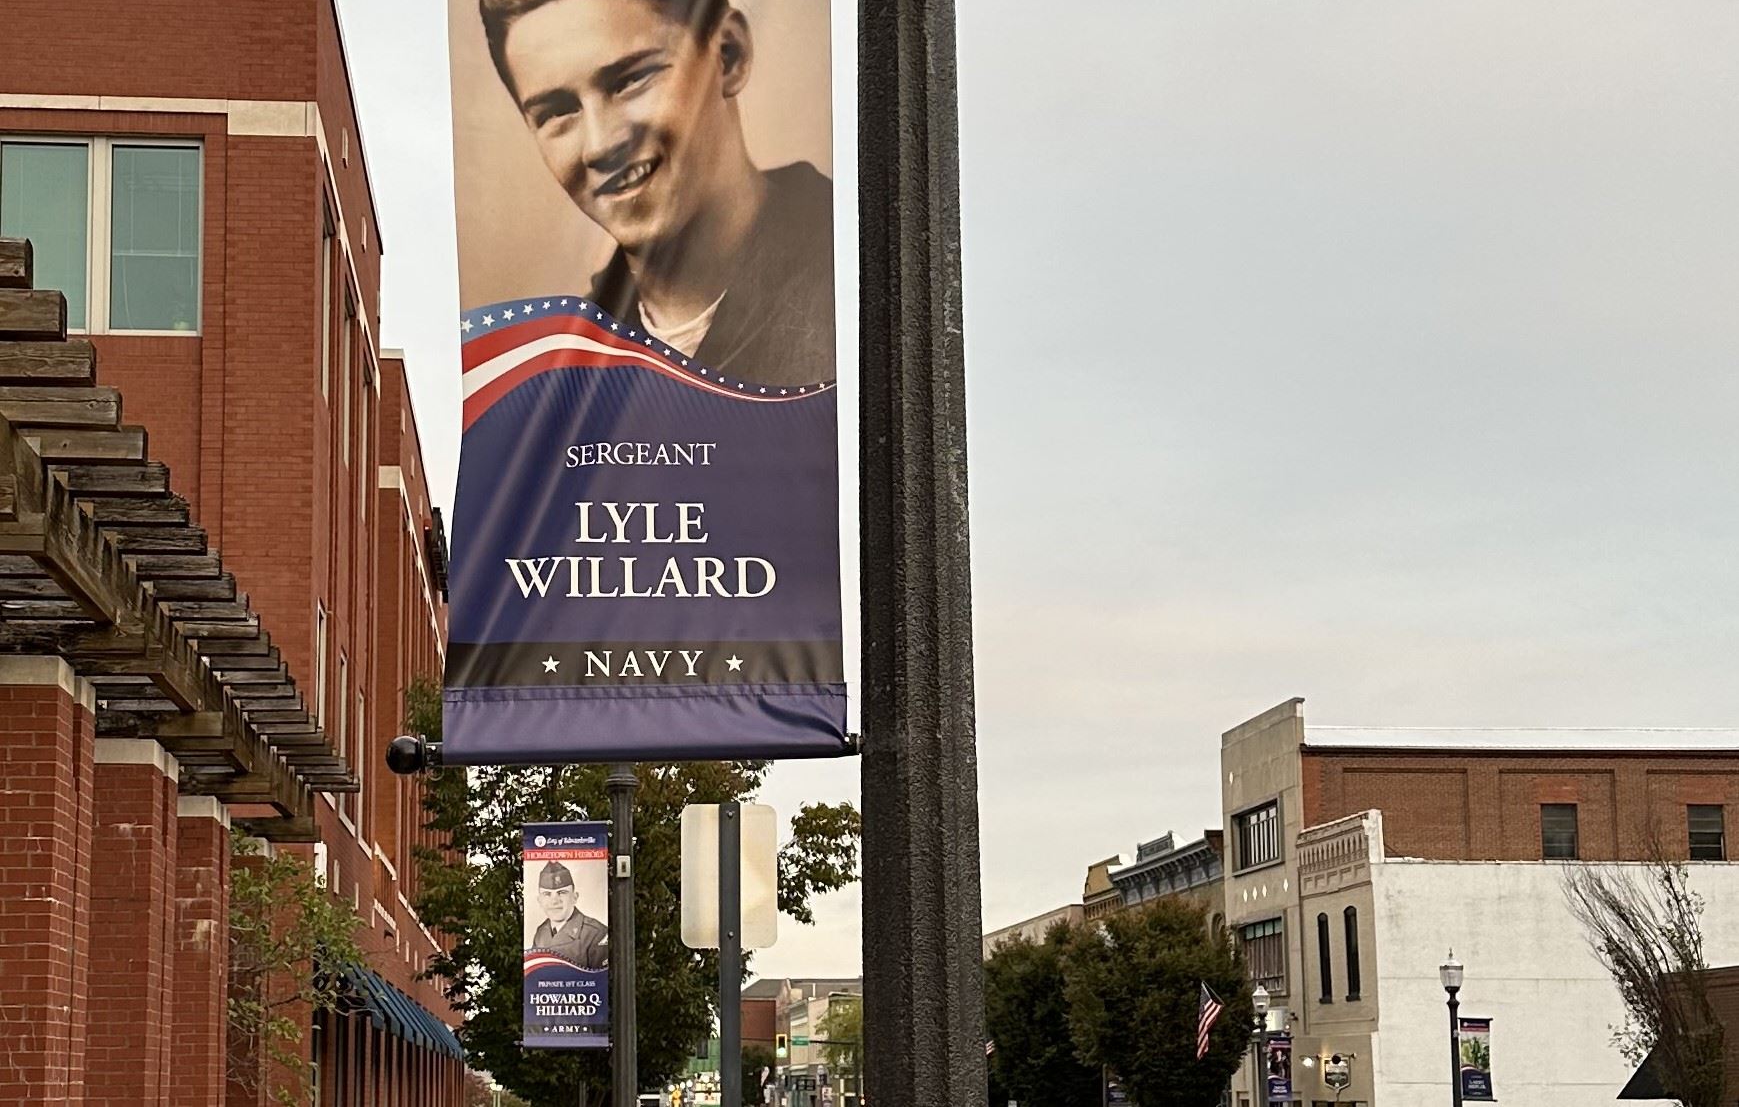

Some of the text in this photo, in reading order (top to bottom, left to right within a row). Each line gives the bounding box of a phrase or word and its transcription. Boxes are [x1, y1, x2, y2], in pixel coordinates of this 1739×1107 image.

[566, 443, 716, 468] SERGEANT
[575, 501, 709, 544] LYLE
[505, 556, 777, 599] WILLARD
[584, 650, 704, 677] NAVY
[530, 994, 586, 1004] HOWARD
[536, 1006, 596, 1015] HILLIARD
